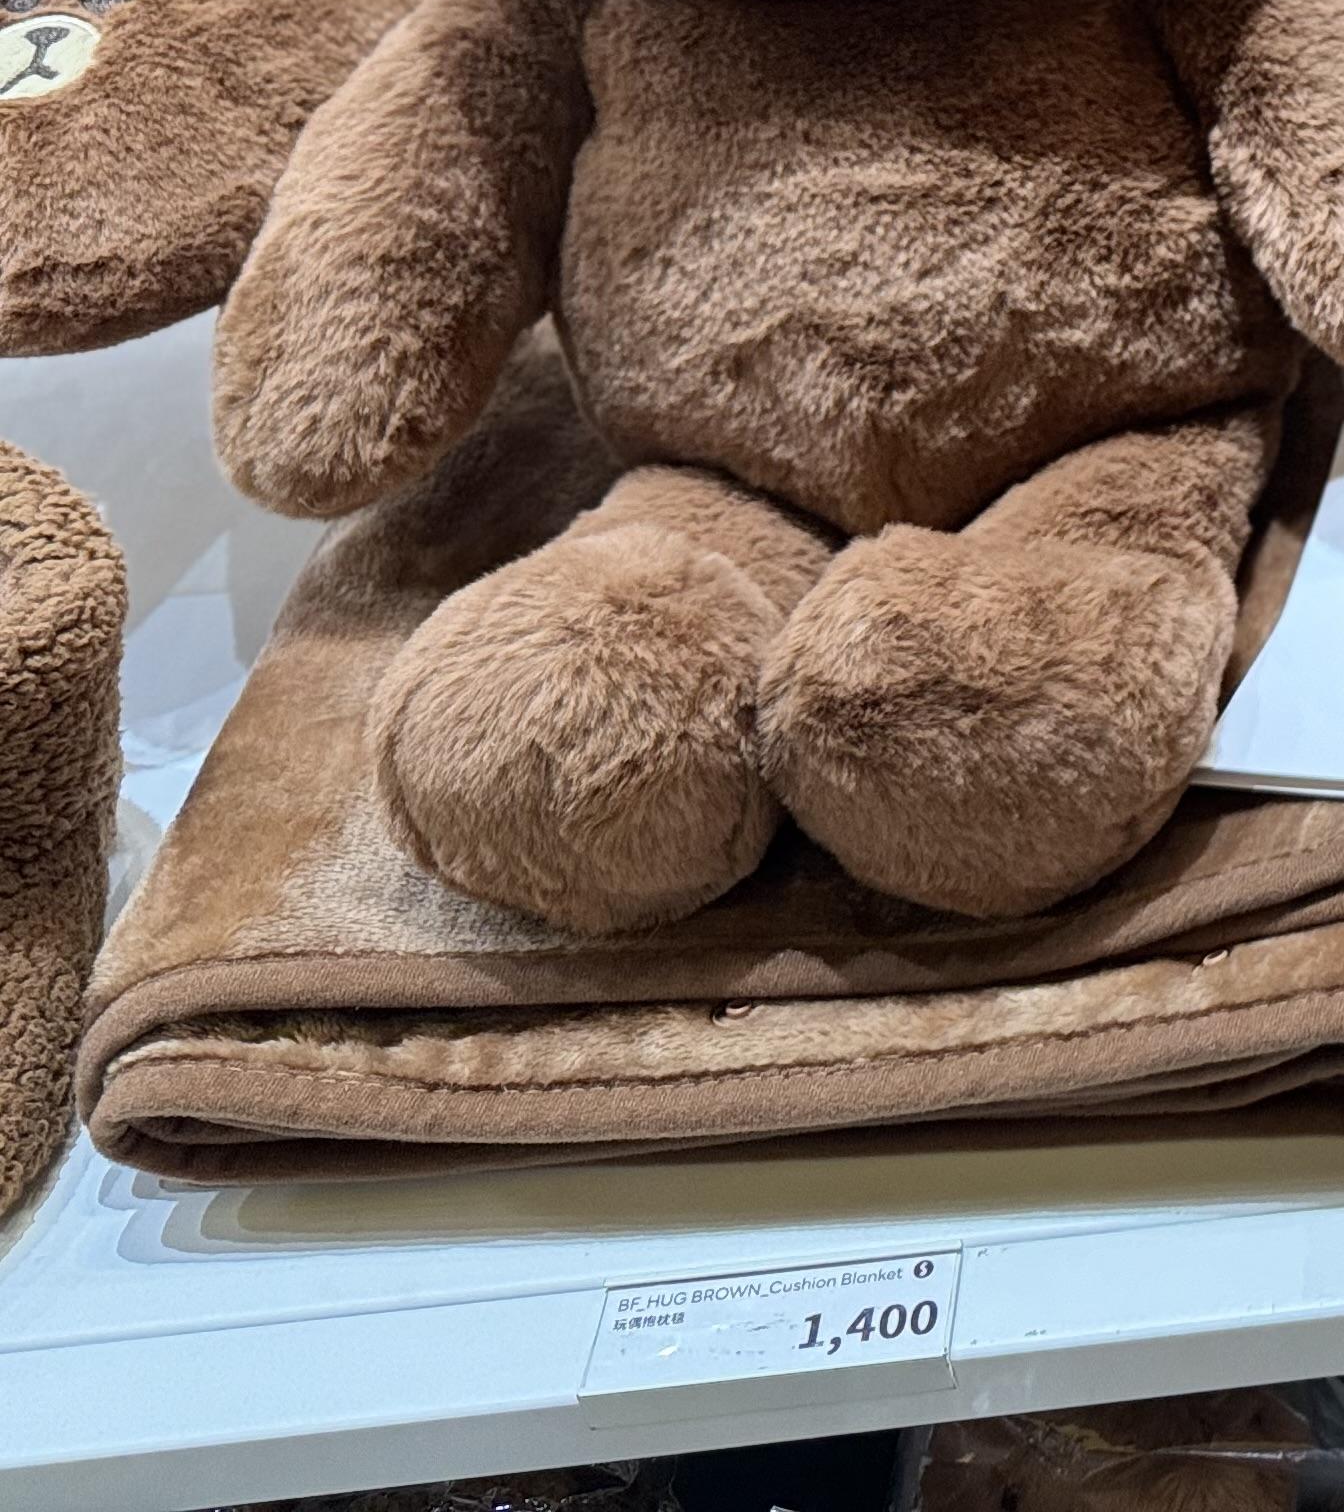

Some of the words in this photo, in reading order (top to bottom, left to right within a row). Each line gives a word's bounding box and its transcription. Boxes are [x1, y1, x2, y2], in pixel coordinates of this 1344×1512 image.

[617, 1291, 687, 1313] BF_HUG
[690, 1278, 837, 1304] BROWN_Cushion
[841, 1267, 904, 1287] Blanket
[799, 1300, 938, 1356] 1,400
